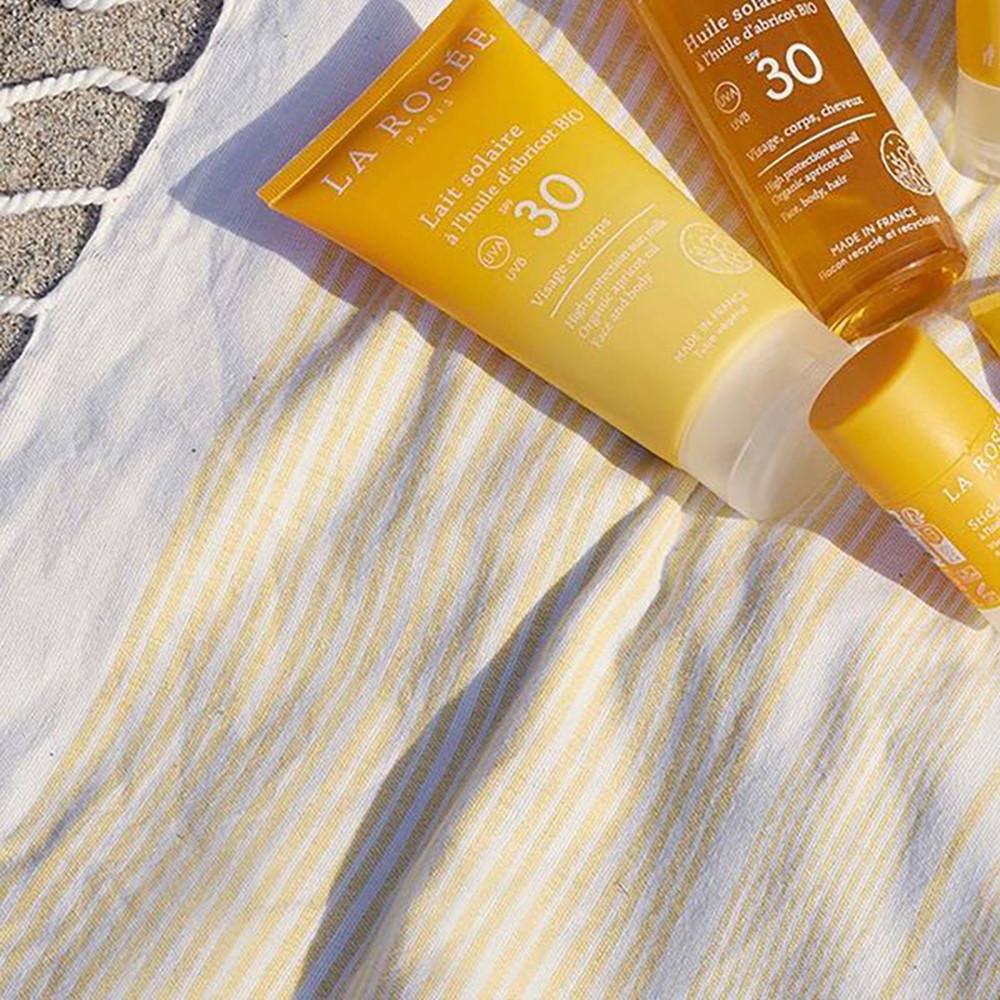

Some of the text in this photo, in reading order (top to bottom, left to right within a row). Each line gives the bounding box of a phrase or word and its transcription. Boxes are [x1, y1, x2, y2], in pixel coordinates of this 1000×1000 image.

[683, 16, 729, 54] Huile
[702, 35, 741, 67] l'huile
[743, 10, 799, 41] d'abricot
[797, 1, 818, 18] BIO
[744, 50, 760, 65] SPF
[756, 42, 824, 101] 30
[321, 26, 497, 196] LA ROSÉE
[407, 99, 454, 145] PARIS
[783, 112, 822, 138] corps,
[821, 96, 865, 117] cheveux
[419, 124, 524, 230] Lait solaire
[443, 107, 584, 247] à l'huile d'abricot BIO
[783, 148, 831, 182] protection
[829, 138, 848, 152] sun
[846, 131, 860, 145] oil
[804, 159, 842, 188] apricot
[839, 150, 854, 165] oil
[513, 173, 585, 237] 30
[826, 175, 848, 192] hair
[483, 239, 506, 266] UVA
[830, 205, 918, 257] MADE IN FRANCE
[885, 228, 898, 241] et
[505, 256, 528, 281] UVB
[531, 263, 571, 307] Visage
[579, 217, 612, 250] corps
[942, 476, 974, 504] LA
